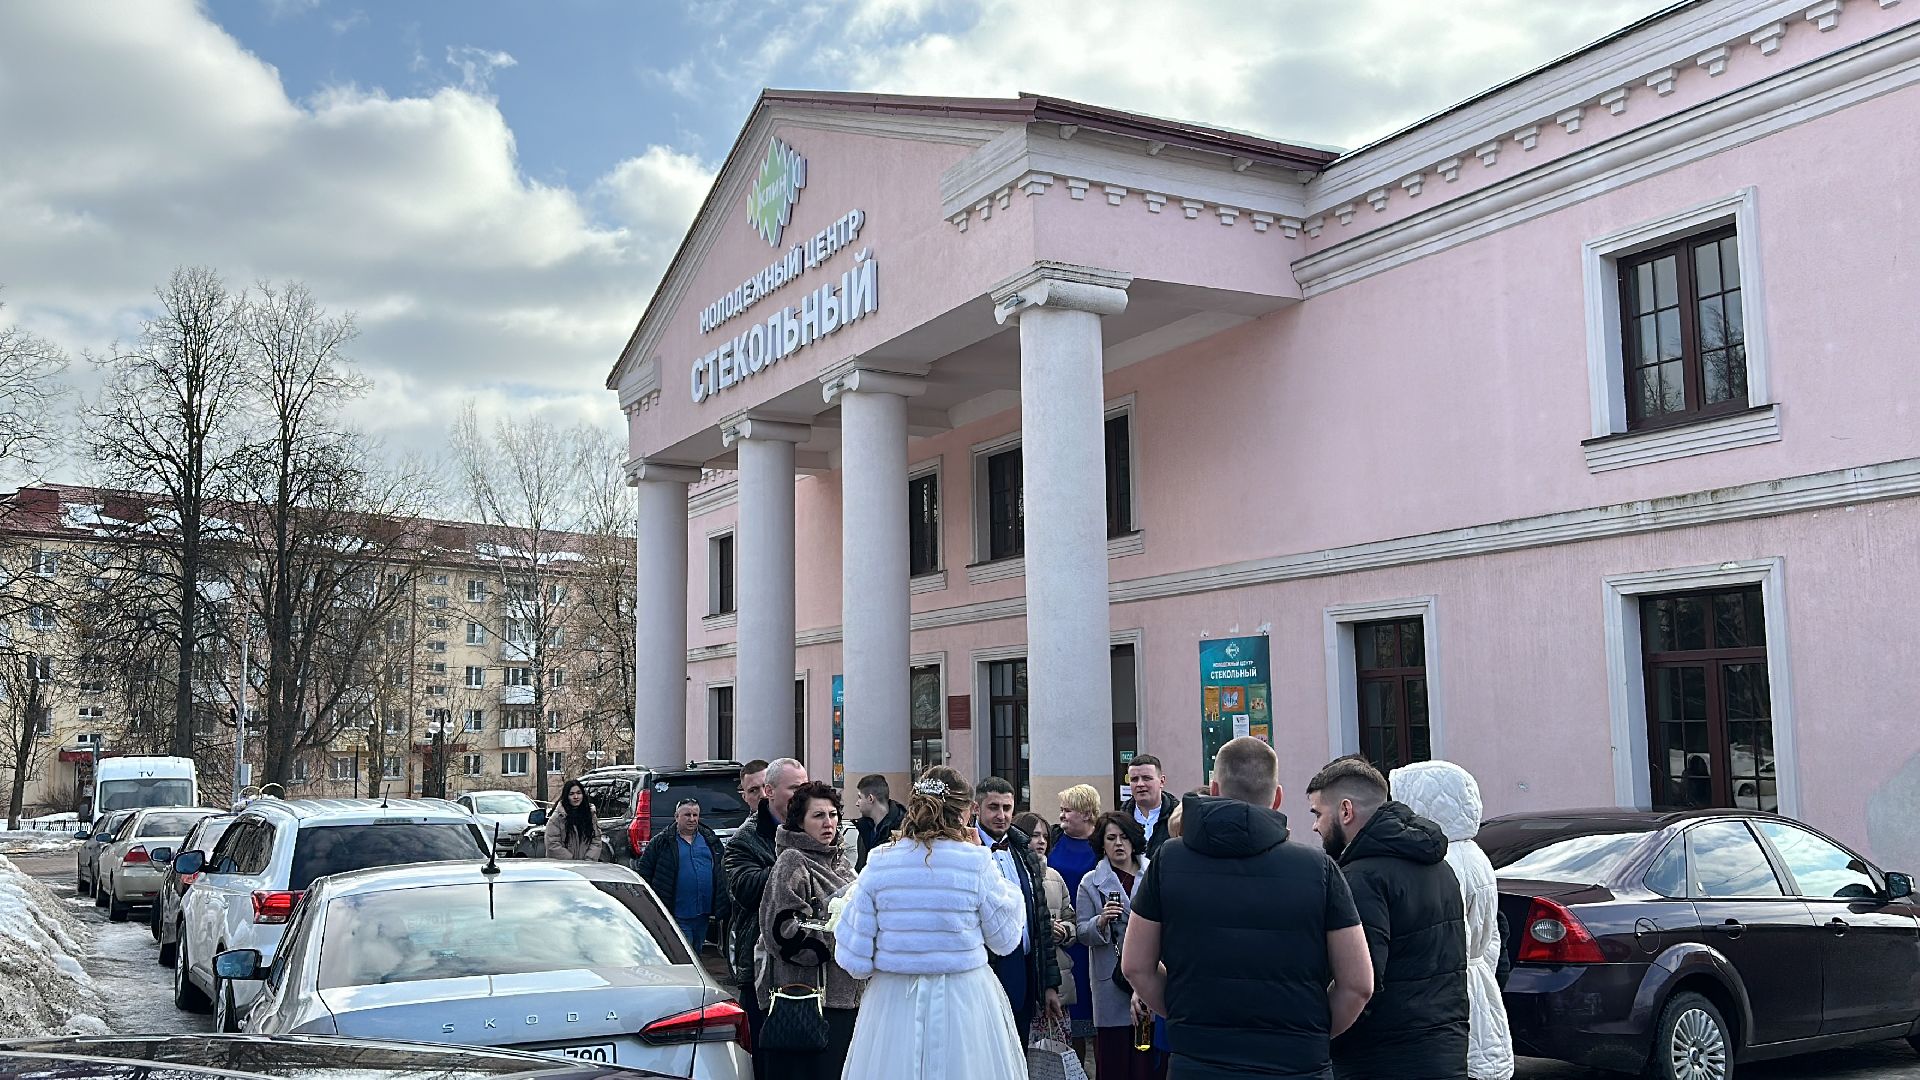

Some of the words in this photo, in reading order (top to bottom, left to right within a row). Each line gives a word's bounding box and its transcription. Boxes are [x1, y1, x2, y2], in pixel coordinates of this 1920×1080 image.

[700, 245, 802, 334] МОЛОДЕЖНЫЙ
[805, 208, 864, 268] ЦЕНТР
[691, 248, 877, 403] СТЕКОЛЬНЫЙ
[1210, 667, 1257, 679] СТЕКОЛЬНЫЙ
[442, 1010, 618, 1033] SKODA
